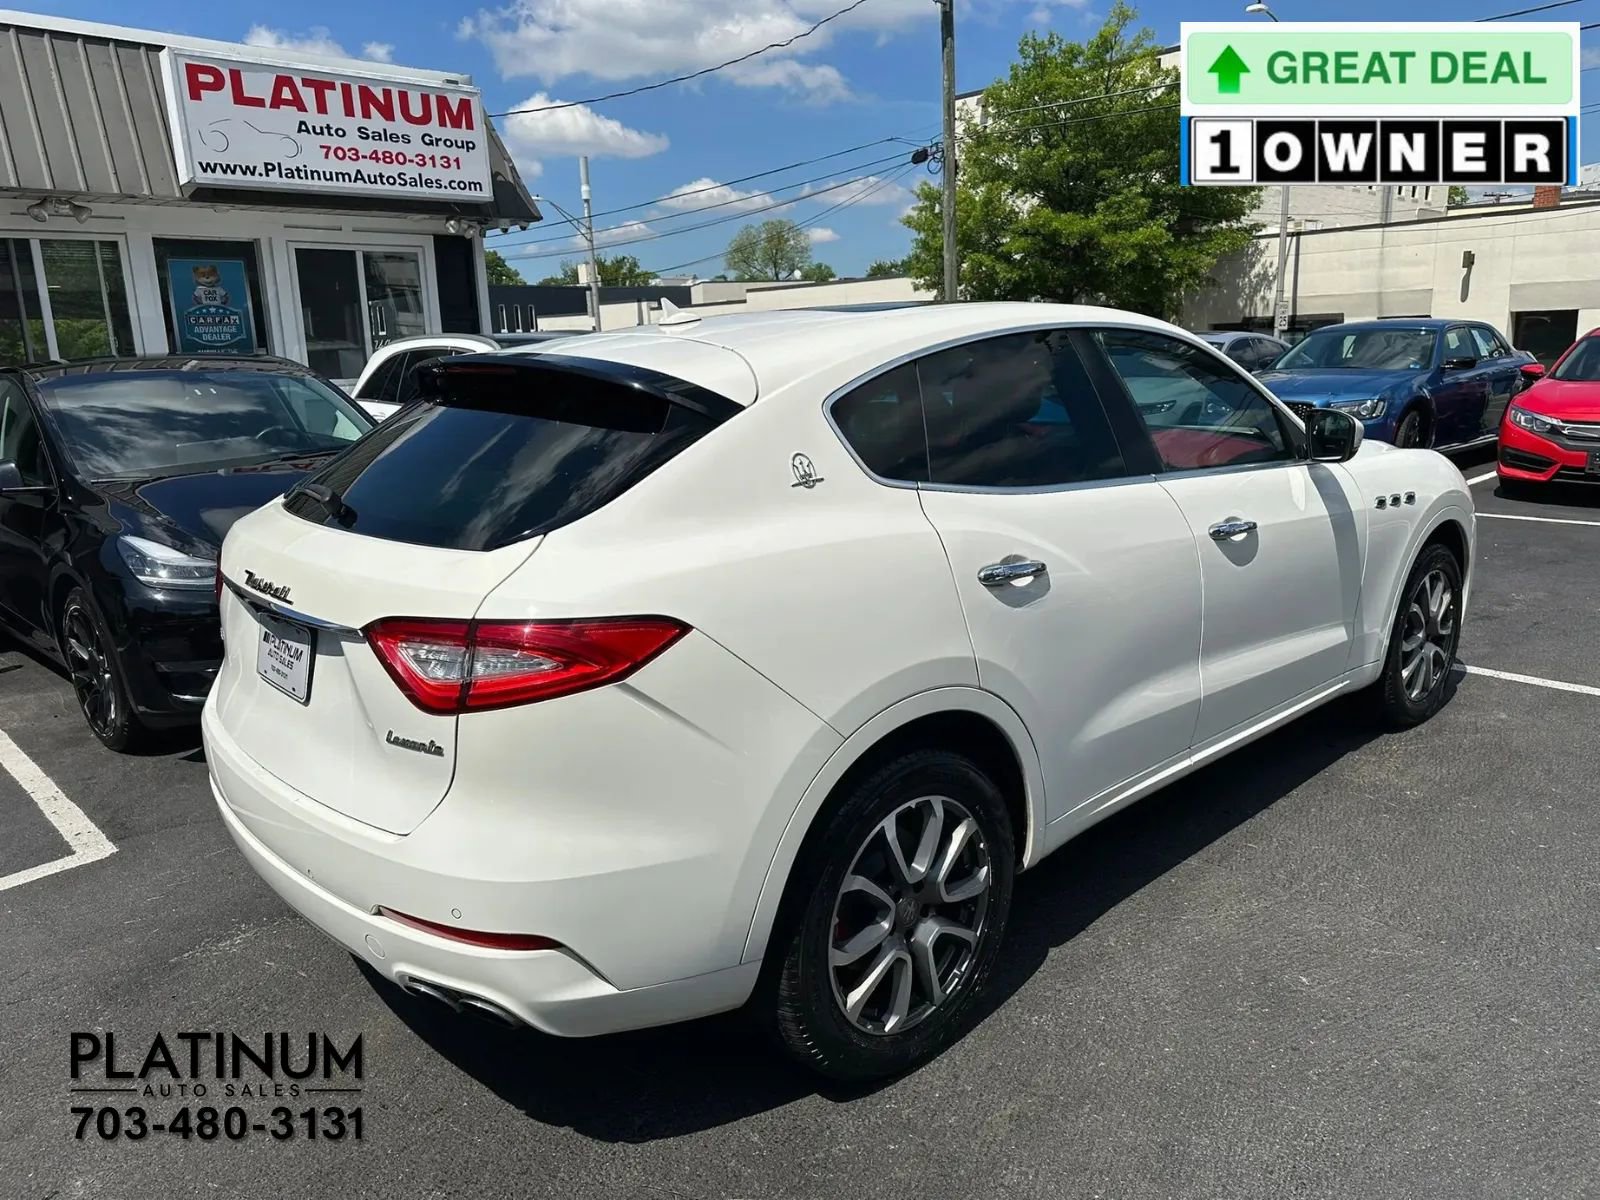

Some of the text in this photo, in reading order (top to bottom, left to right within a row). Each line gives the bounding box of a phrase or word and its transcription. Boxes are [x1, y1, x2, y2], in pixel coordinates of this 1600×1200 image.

[185, 62, 475, 131] PLATINUM
[296, 120, 476, 152] Auto Sales Group
[319, 144, 462, 170] 703-480-3131
[198, 161, 483, 192] www.PlatinumAutoSales.com
[189, 315, 239, 325] CARFAX
[194, 325, 238, 333] ADVANTAGE
[202, 333, 232, 341] DEALER
